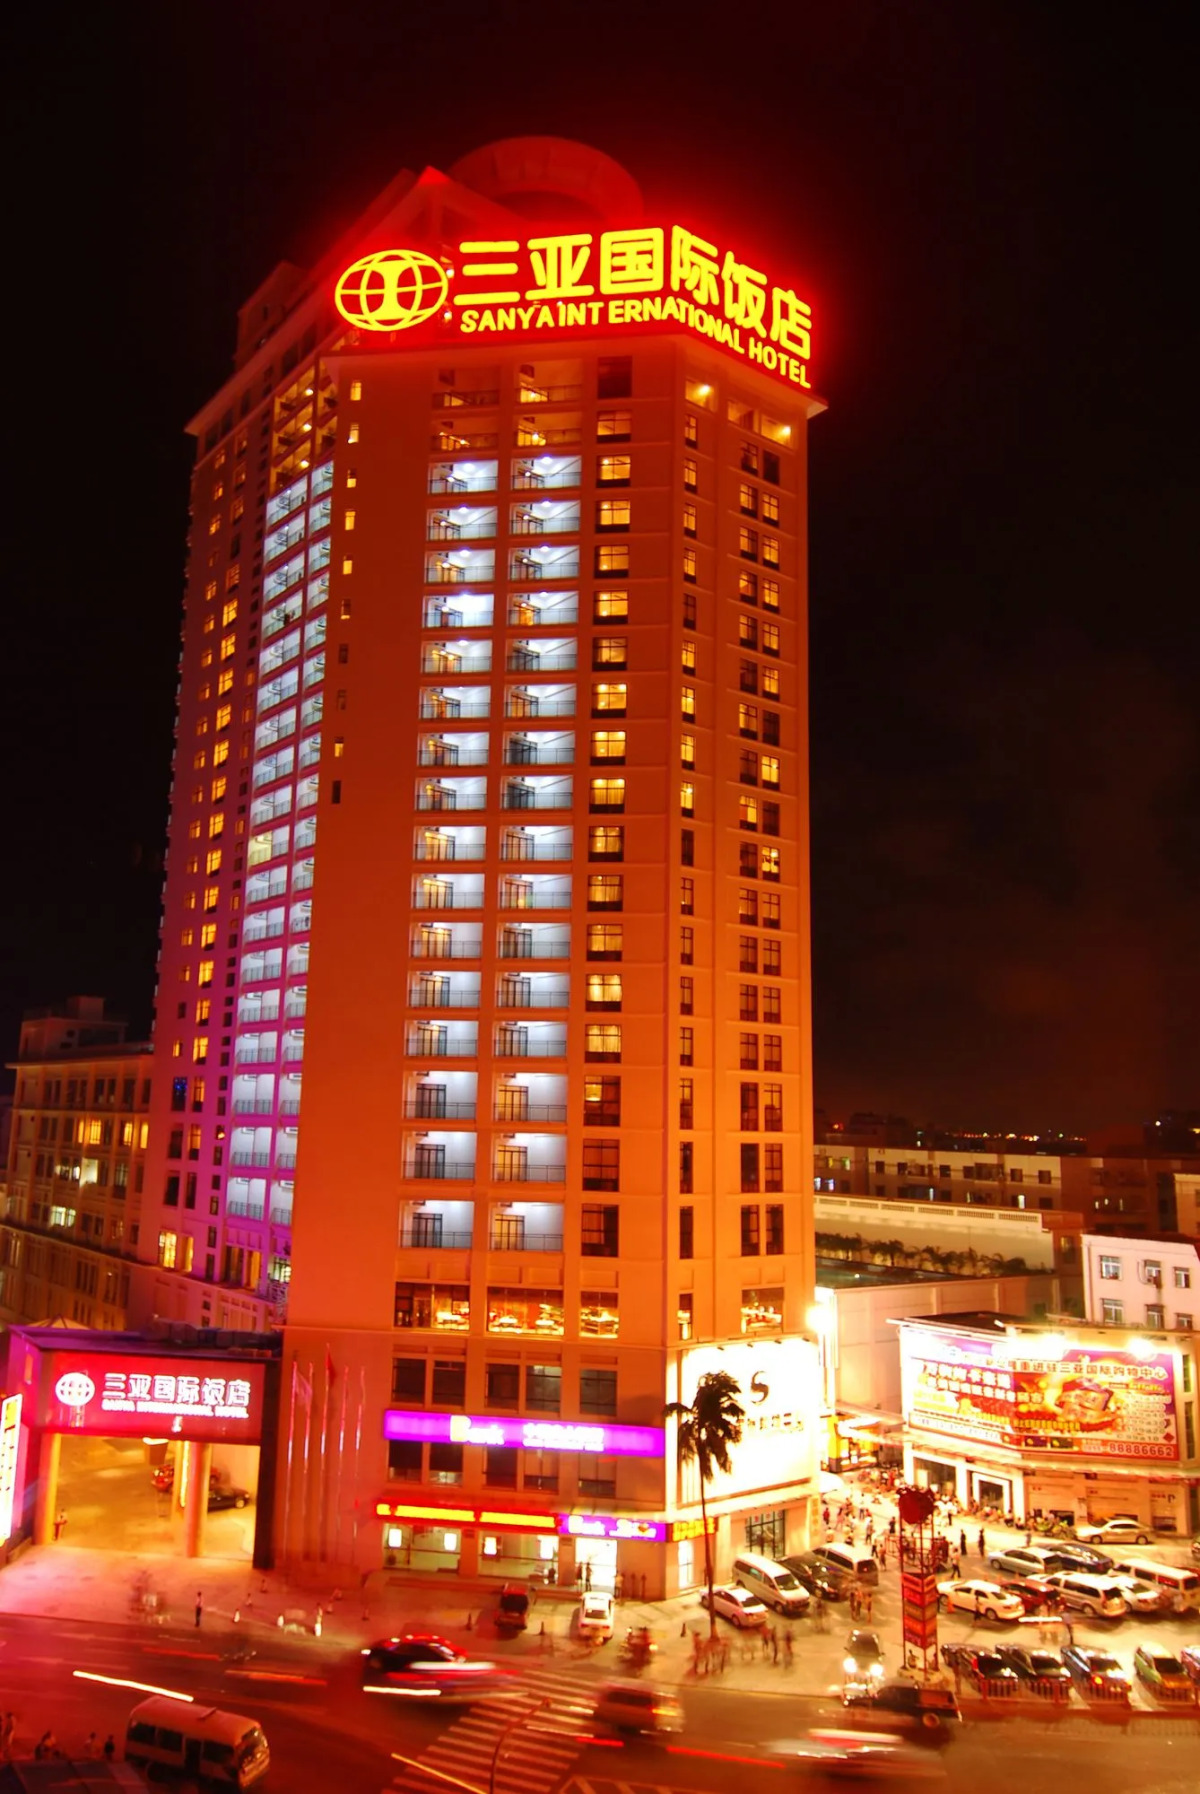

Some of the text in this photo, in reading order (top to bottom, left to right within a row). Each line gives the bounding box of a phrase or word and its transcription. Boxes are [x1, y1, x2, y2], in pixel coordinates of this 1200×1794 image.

[453, 224, 812, 359] 三亚国际饭店
[460, 306, 554, 333] SANYA
[749, 337, 811, 389] HOTEL
[102, 1373, 250, 1407] 三亚国际饭店
[1109, 1441, 1173, 1457] 88886662
